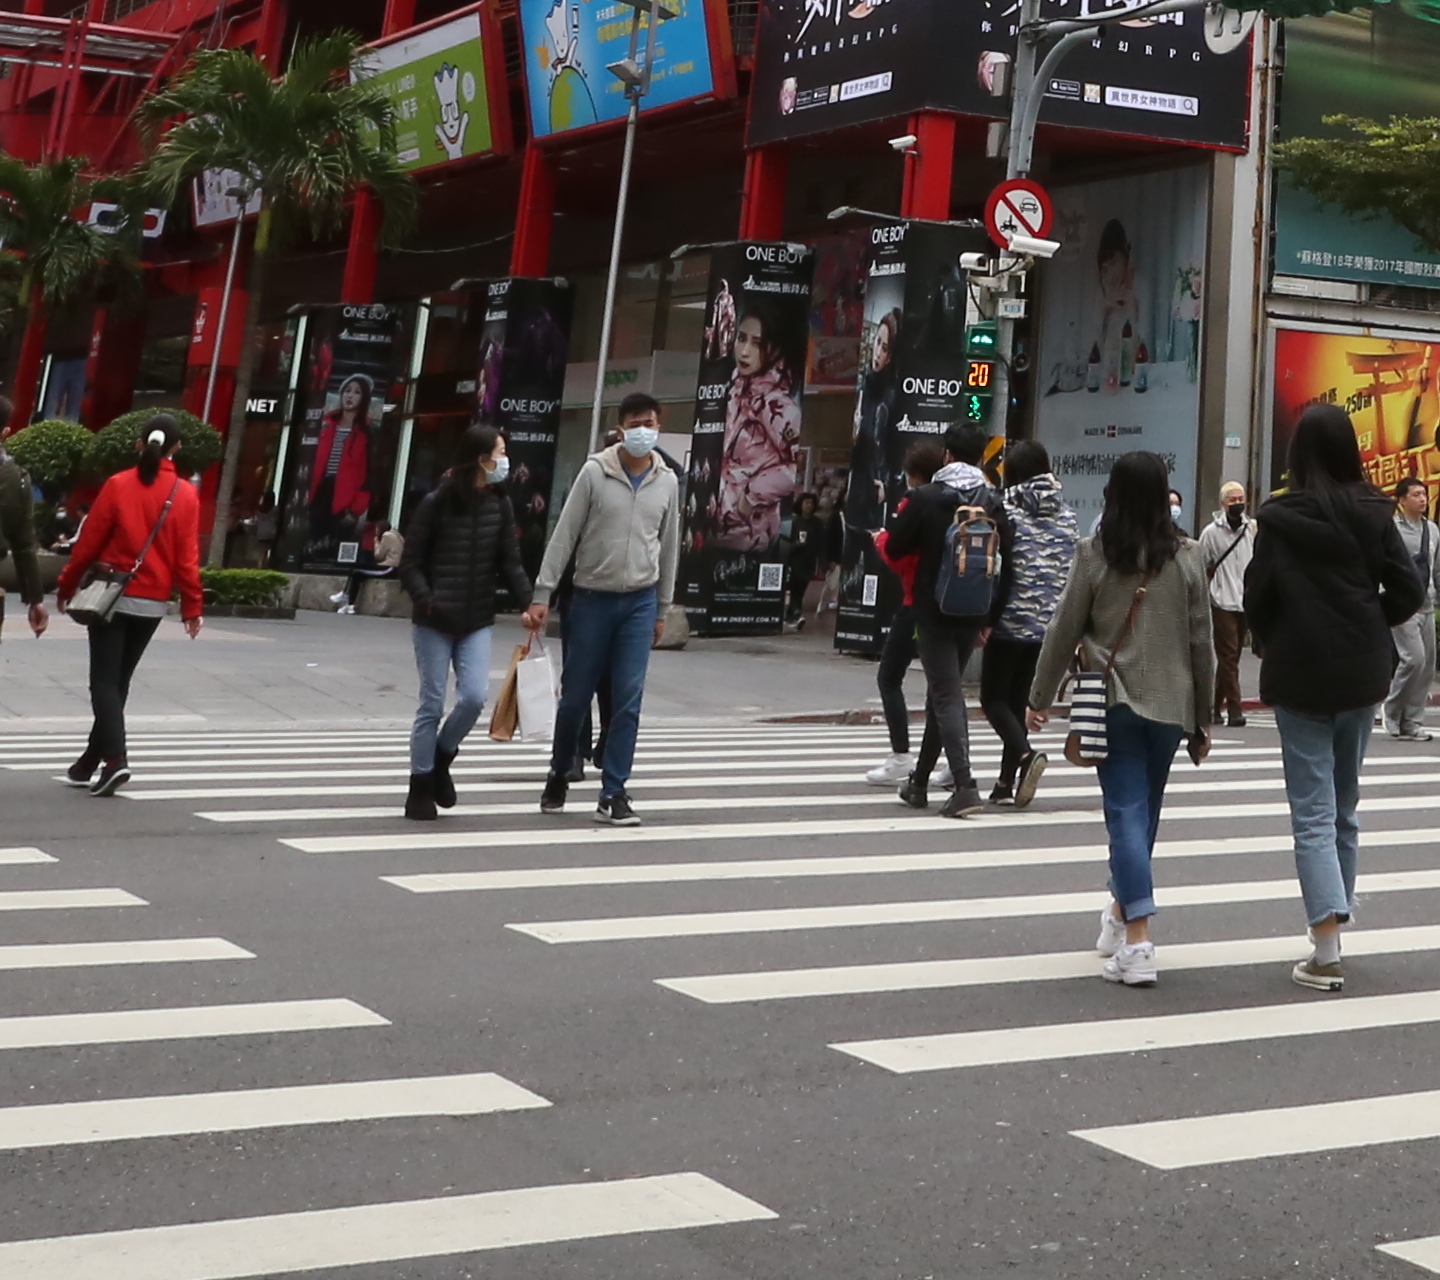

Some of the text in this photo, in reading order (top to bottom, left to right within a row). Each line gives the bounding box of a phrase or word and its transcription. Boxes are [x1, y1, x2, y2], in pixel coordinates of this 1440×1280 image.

[1110, 89, 1177, 110] 異世界女神物語
[872, 223, 906, 244] ONE BOY
[745, 245, 804, 265] ONE BOY
[342, 305, 390, 321] ONE BOY
[968, 362, 989, 388] 20
[698, 384, 713, 401] ONE
[902, 376, 963, 397] ONE BO
[245, 398, 278, 414] NET
[500, 397, 555, 415] ONE BOY
